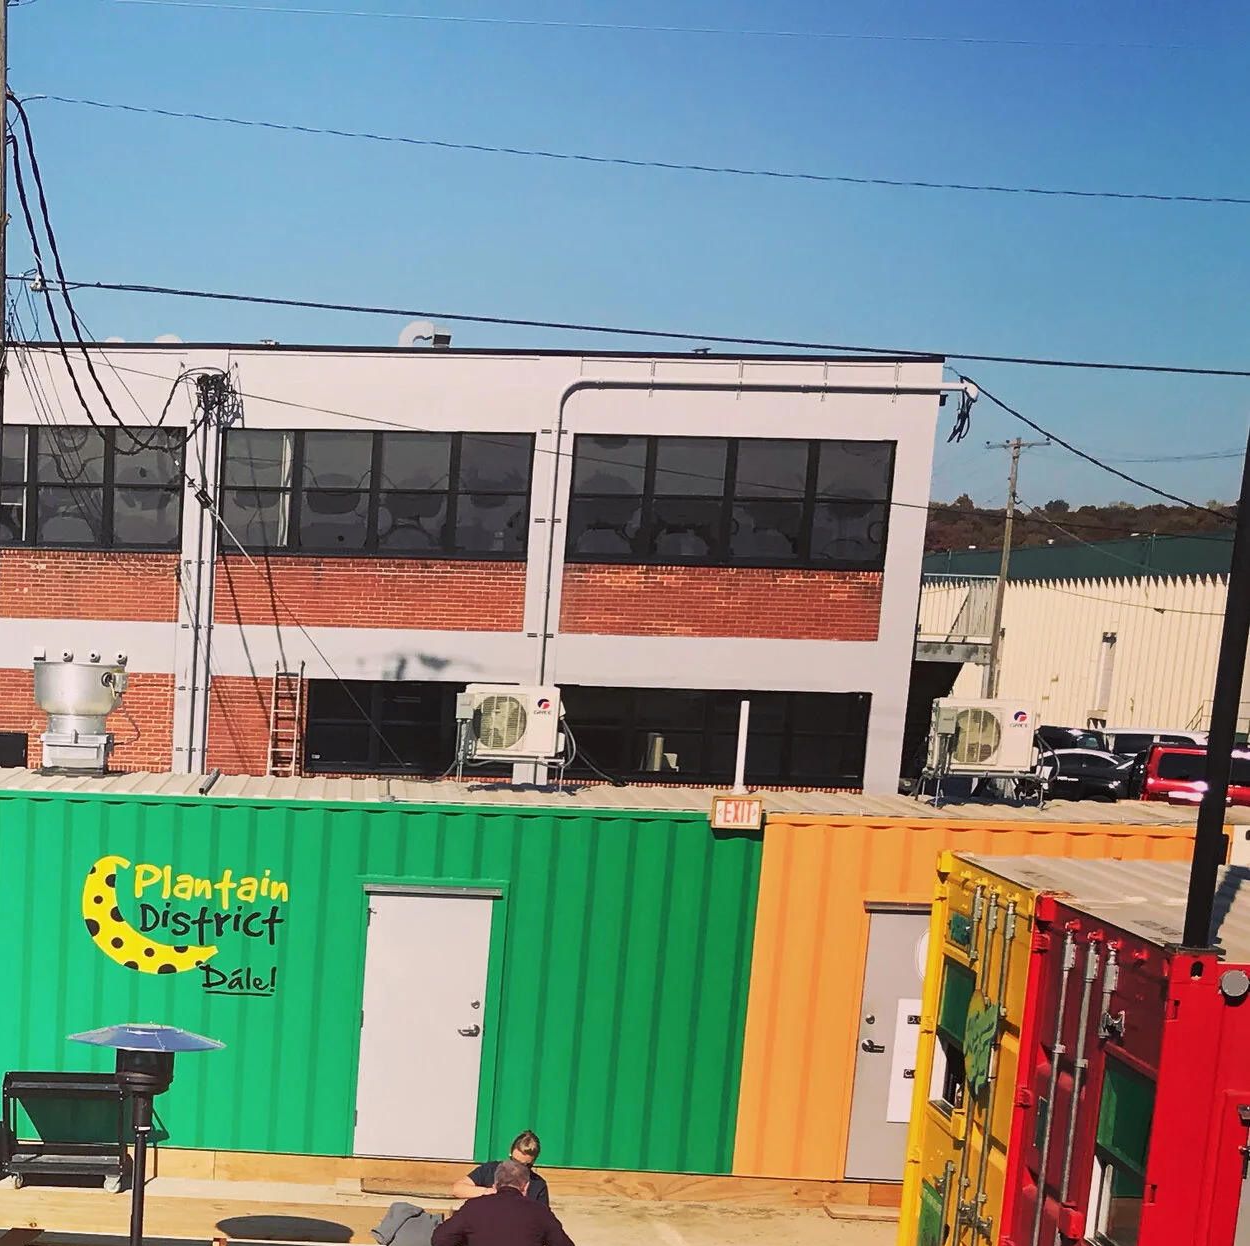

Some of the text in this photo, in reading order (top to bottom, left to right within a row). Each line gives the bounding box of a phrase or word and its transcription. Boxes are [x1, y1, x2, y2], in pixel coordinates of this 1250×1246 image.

[723, 800, 754, 824] EXIT
[134, 863, 289, 911] Plantain
[139, 902, 285, 946] District
[198, 964, 277, 992] Dále!
